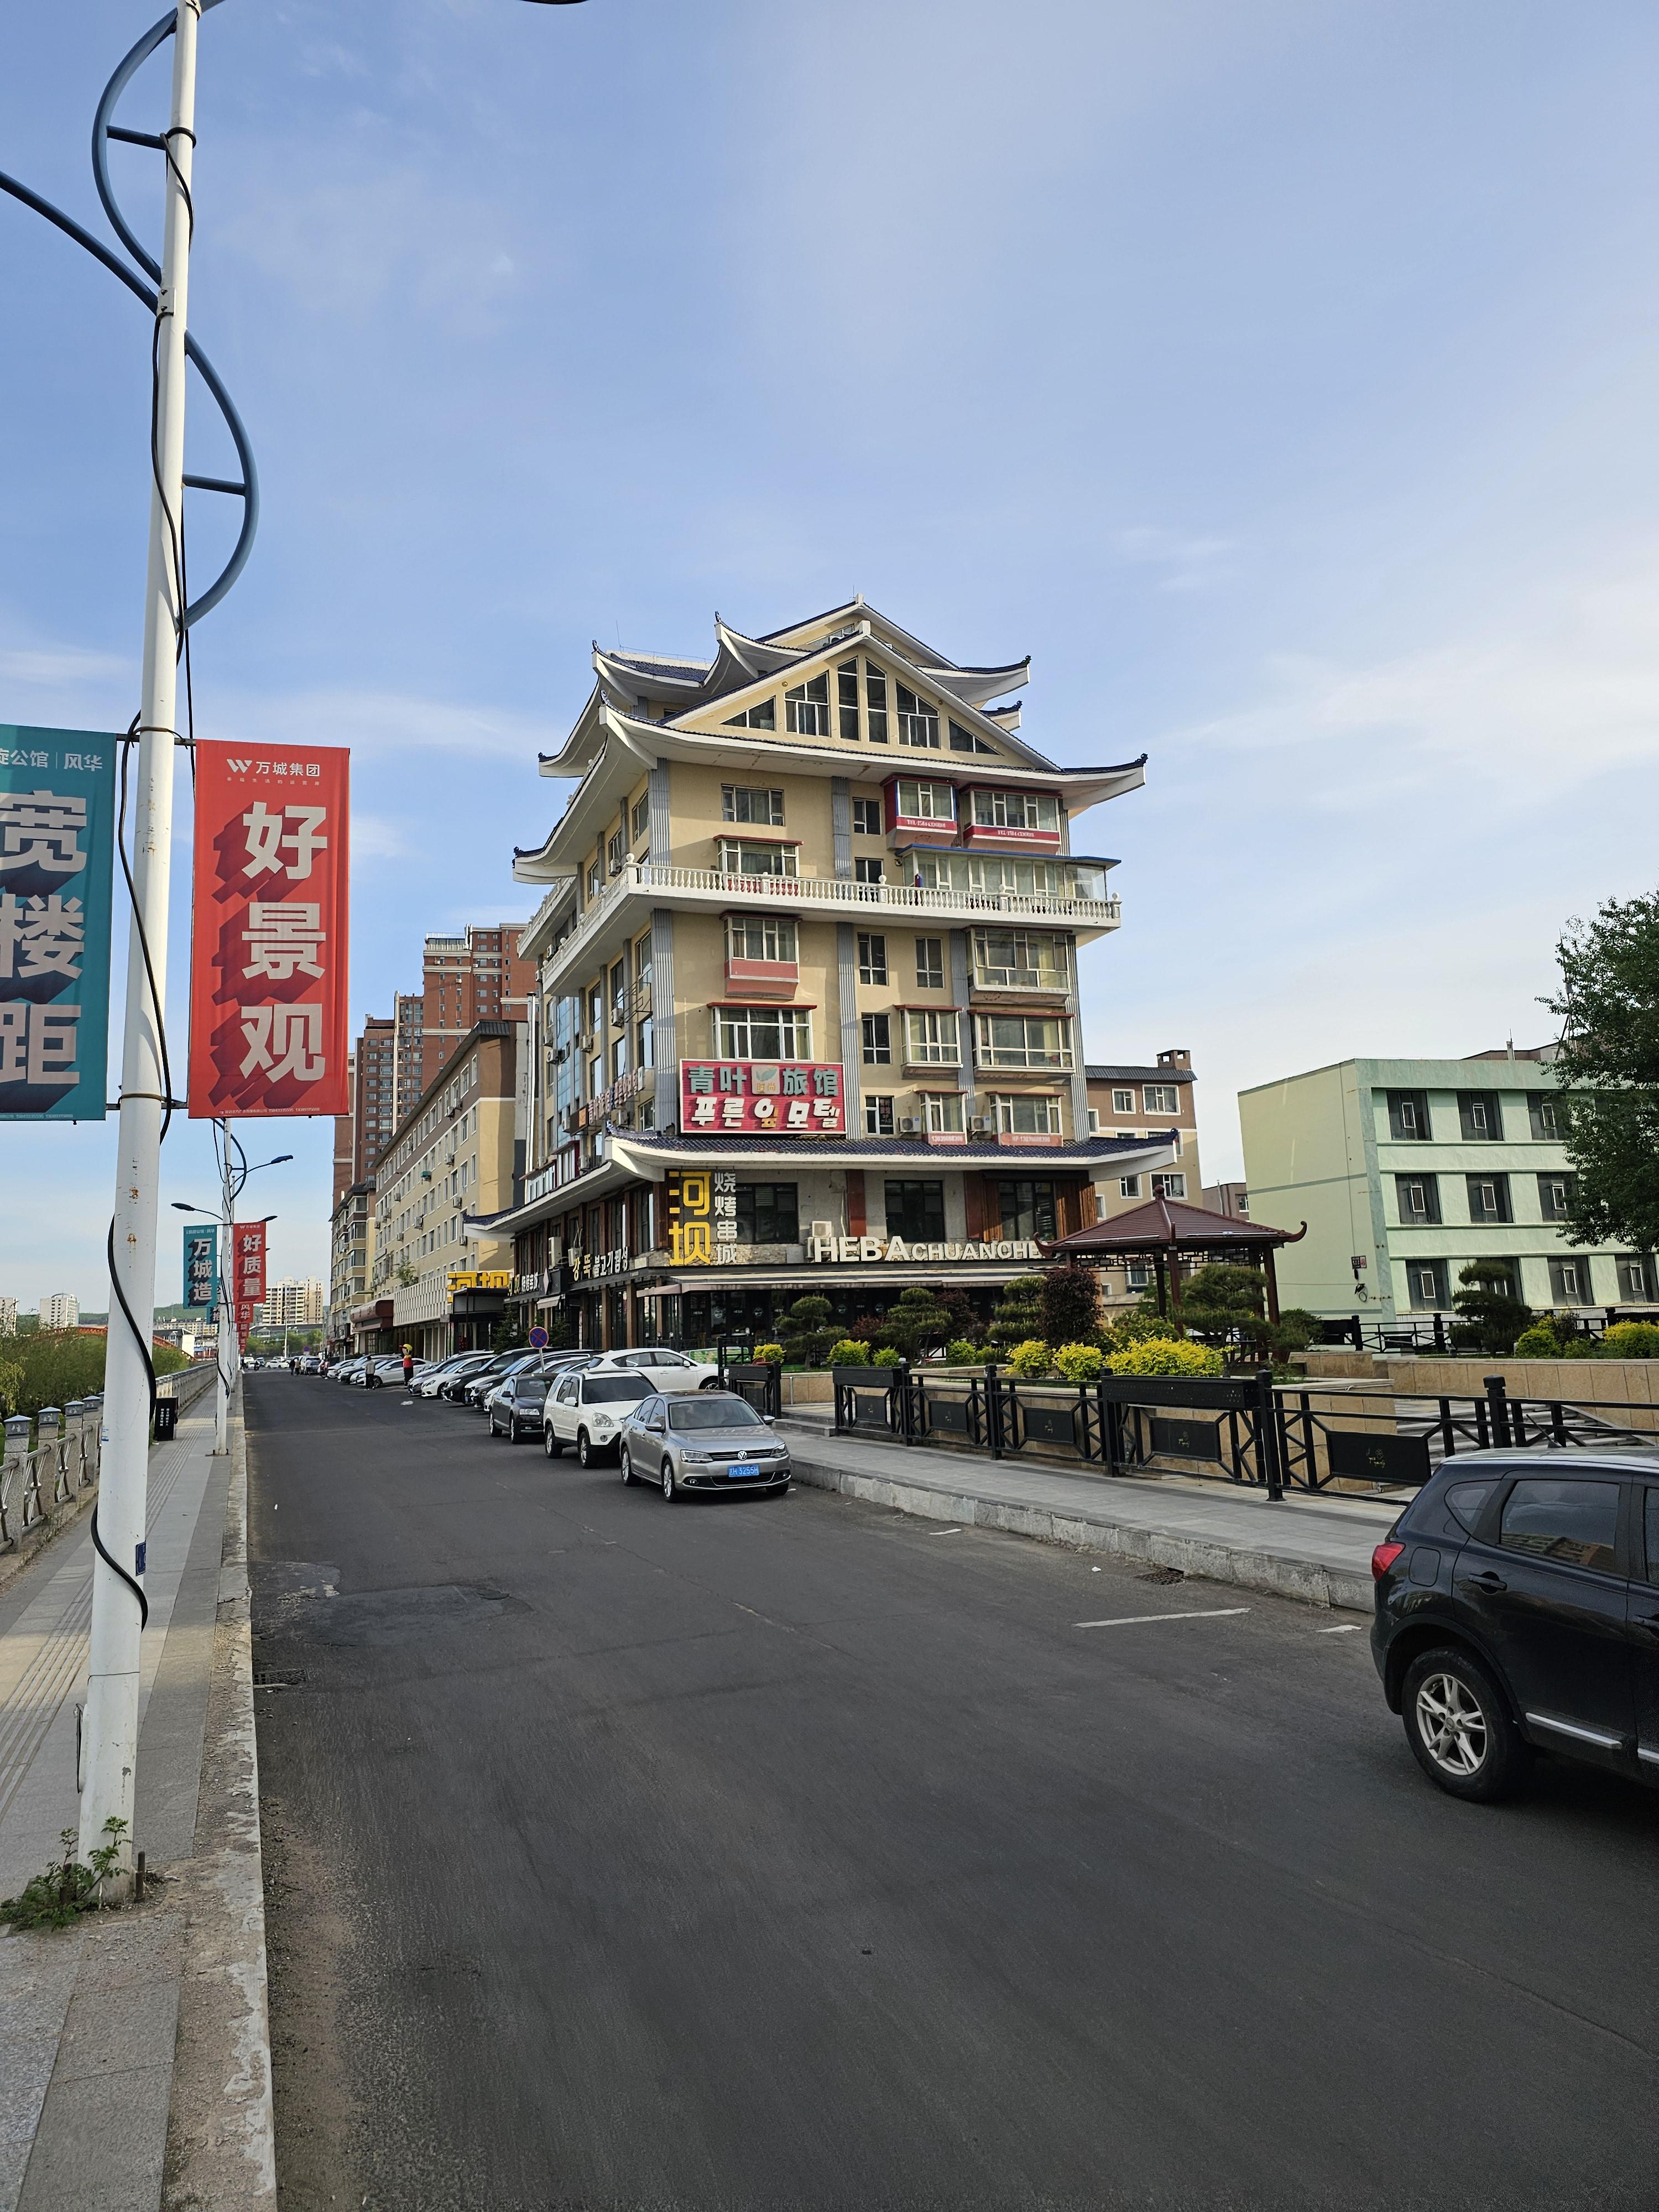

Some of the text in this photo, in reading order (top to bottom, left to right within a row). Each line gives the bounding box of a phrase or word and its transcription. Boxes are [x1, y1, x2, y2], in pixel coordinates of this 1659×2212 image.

[63, 753, 103, 772] 风华
[255, 761, 320, 777] 万城集团
[0, 790, 87, 1084] 宽楼距
[239, 801, 327, 1083] 好景观
[688, 1065, 839, 1097] 青叶 旅馆
[757, 1082, 777, 1094] 时尚
[669, 1171, 711, 1265] 河坝
[714, 1172, 737, 1265] 烧烤串城
[194, 1238, 212, 1301] 万城造
[243, 1234, 262, 1297] 好质量
[813, 1236, 1045, 1262] HEBA CHUANCHE
[739, 1466, 758, 1475] 3255H
